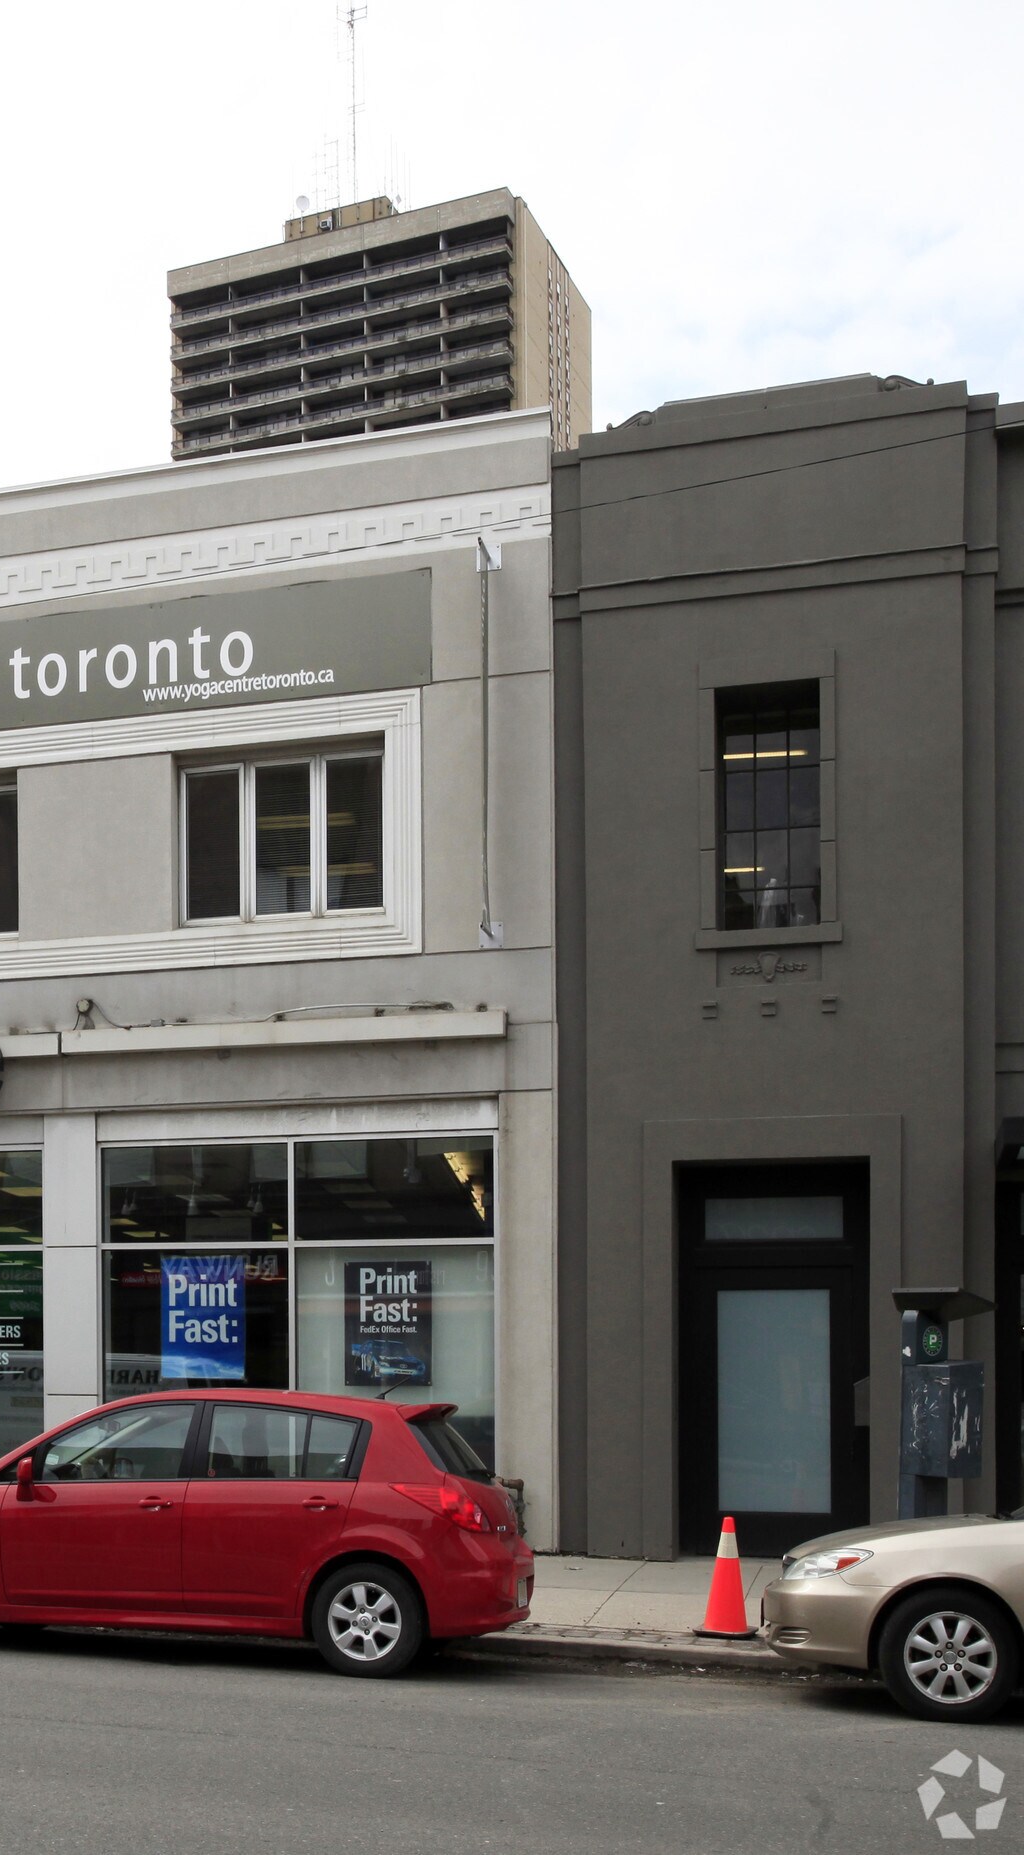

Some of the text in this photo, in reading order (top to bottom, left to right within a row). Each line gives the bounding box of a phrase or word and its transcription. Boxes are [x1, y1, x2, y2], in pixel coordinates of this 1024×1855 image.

[11, 627, 254, 702] toronto
[143, 667, 334, 703] www.yogacentretoronto.ca
[168, 1273, 237, 1307] Print
[359, 1267, 417, 1294] Print
[359, 1295, 417, 1322] Fast:
[168, 1310, 238, 1343] Fast:
[360, 1325, 417, 1334] FedEx Office Fast.
